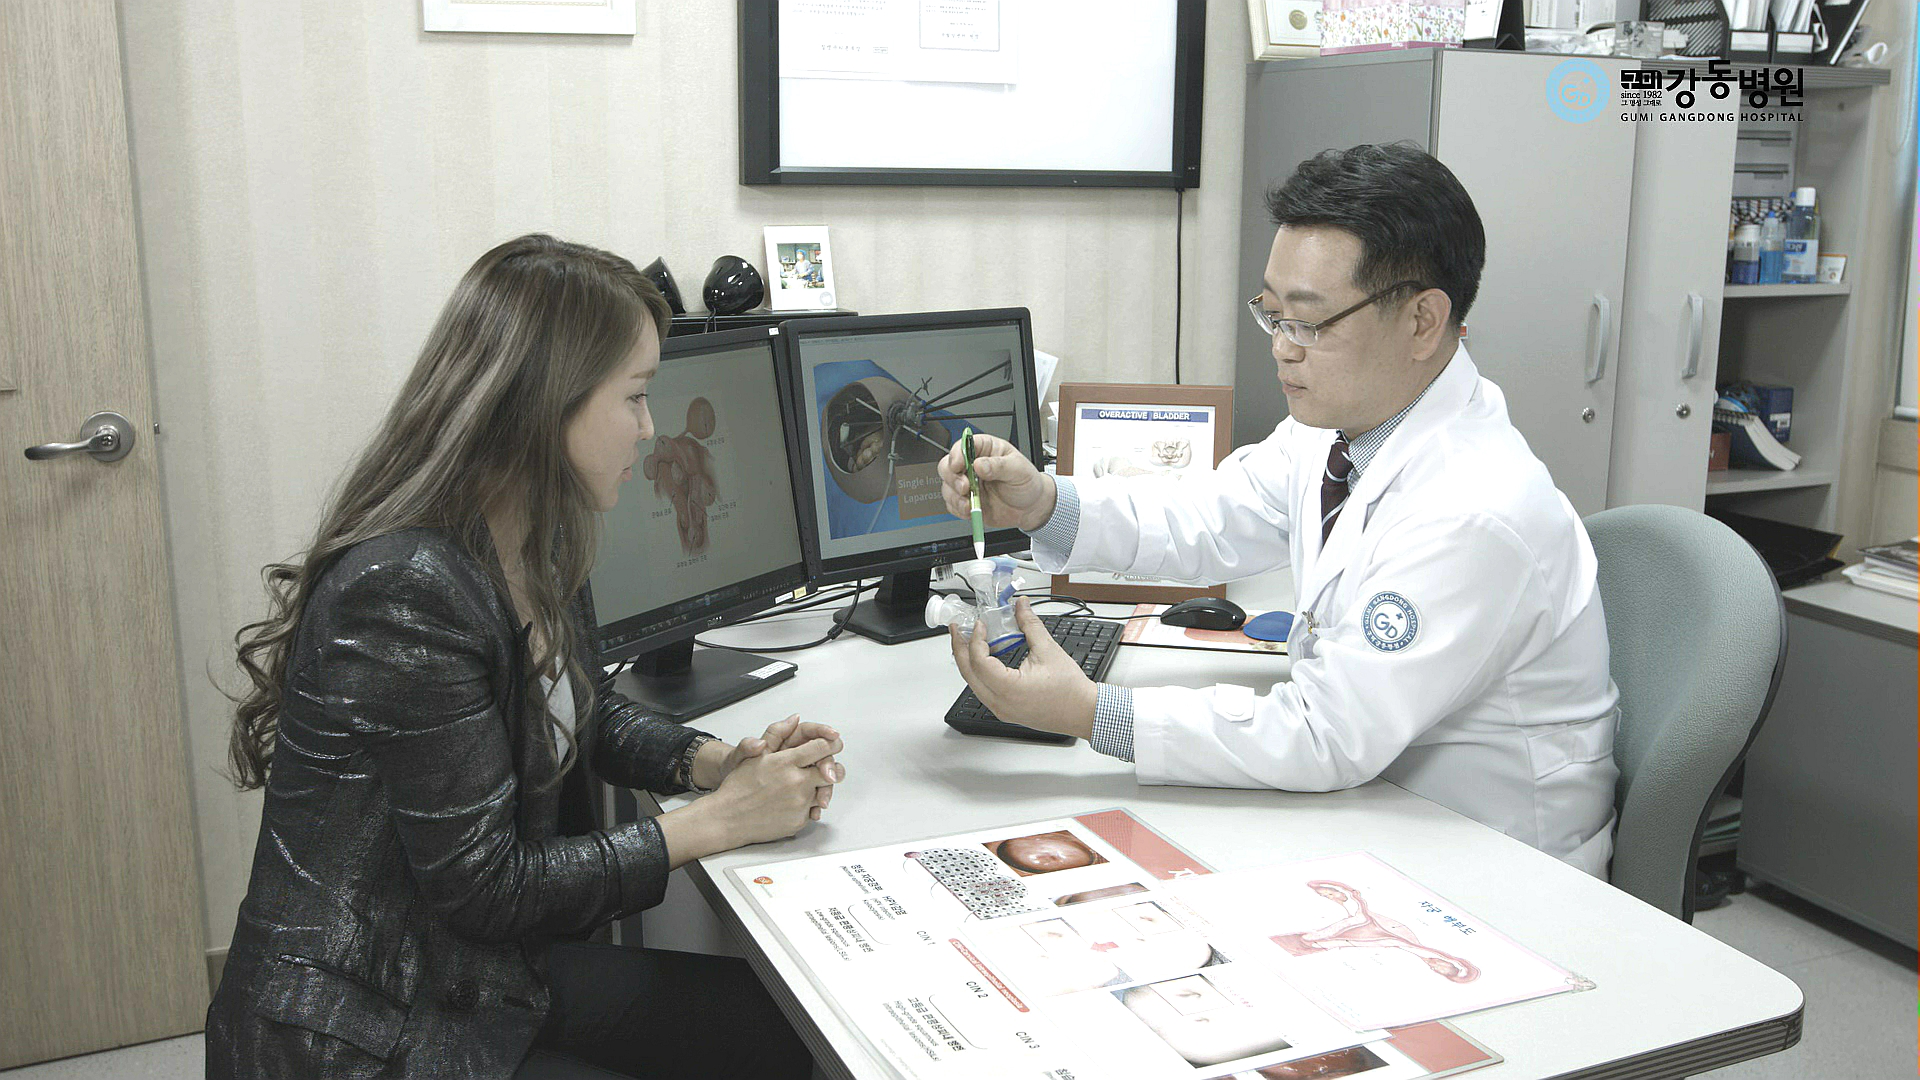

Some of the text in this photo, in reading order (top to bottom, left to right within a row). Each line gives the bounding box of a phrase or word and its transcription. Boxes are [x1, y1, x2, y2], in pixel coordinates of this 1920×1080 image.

[1099, 410, 1191, 421] OVERACTIVE BLADDER
[898, 476, 925, 489] Single
[1374, 612, 1398, 639] GD
[917, 930, 932, 942] CIN
[966, 981, 984, 994] CIN
[1015, 1031, 1034, 1044] CIN
